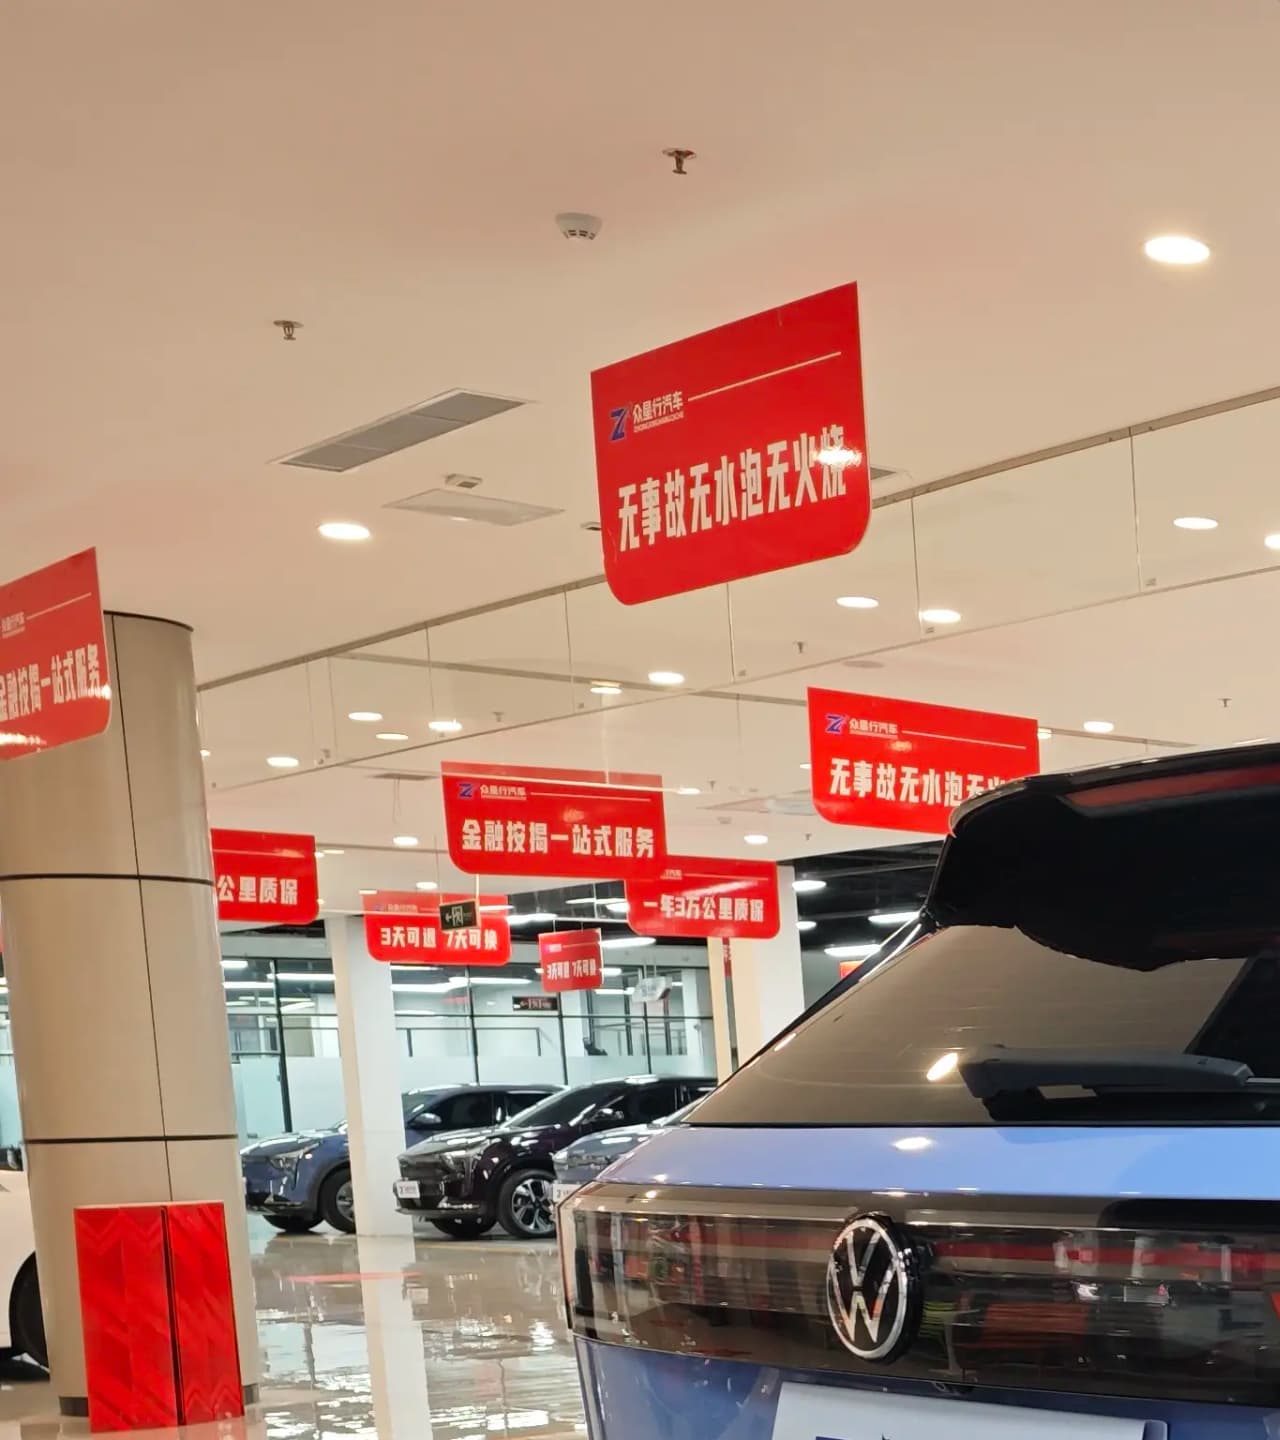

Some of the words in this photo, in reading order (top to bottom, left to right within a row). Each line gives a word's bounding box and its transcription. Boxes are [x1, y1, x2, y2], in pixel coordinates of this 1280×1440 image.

[633, 390, 684, 425] 众星行汽车
[617, 424, 848, 552] 无事故无水泡无火烧
[461, 818, 655, 859] 金融按揭一站式服务
[217, 874, 298, 905] 公里质保
[643, 894, 765, 922] 一年3万公里质保
[379, 926, 437, 948] 3天可退
